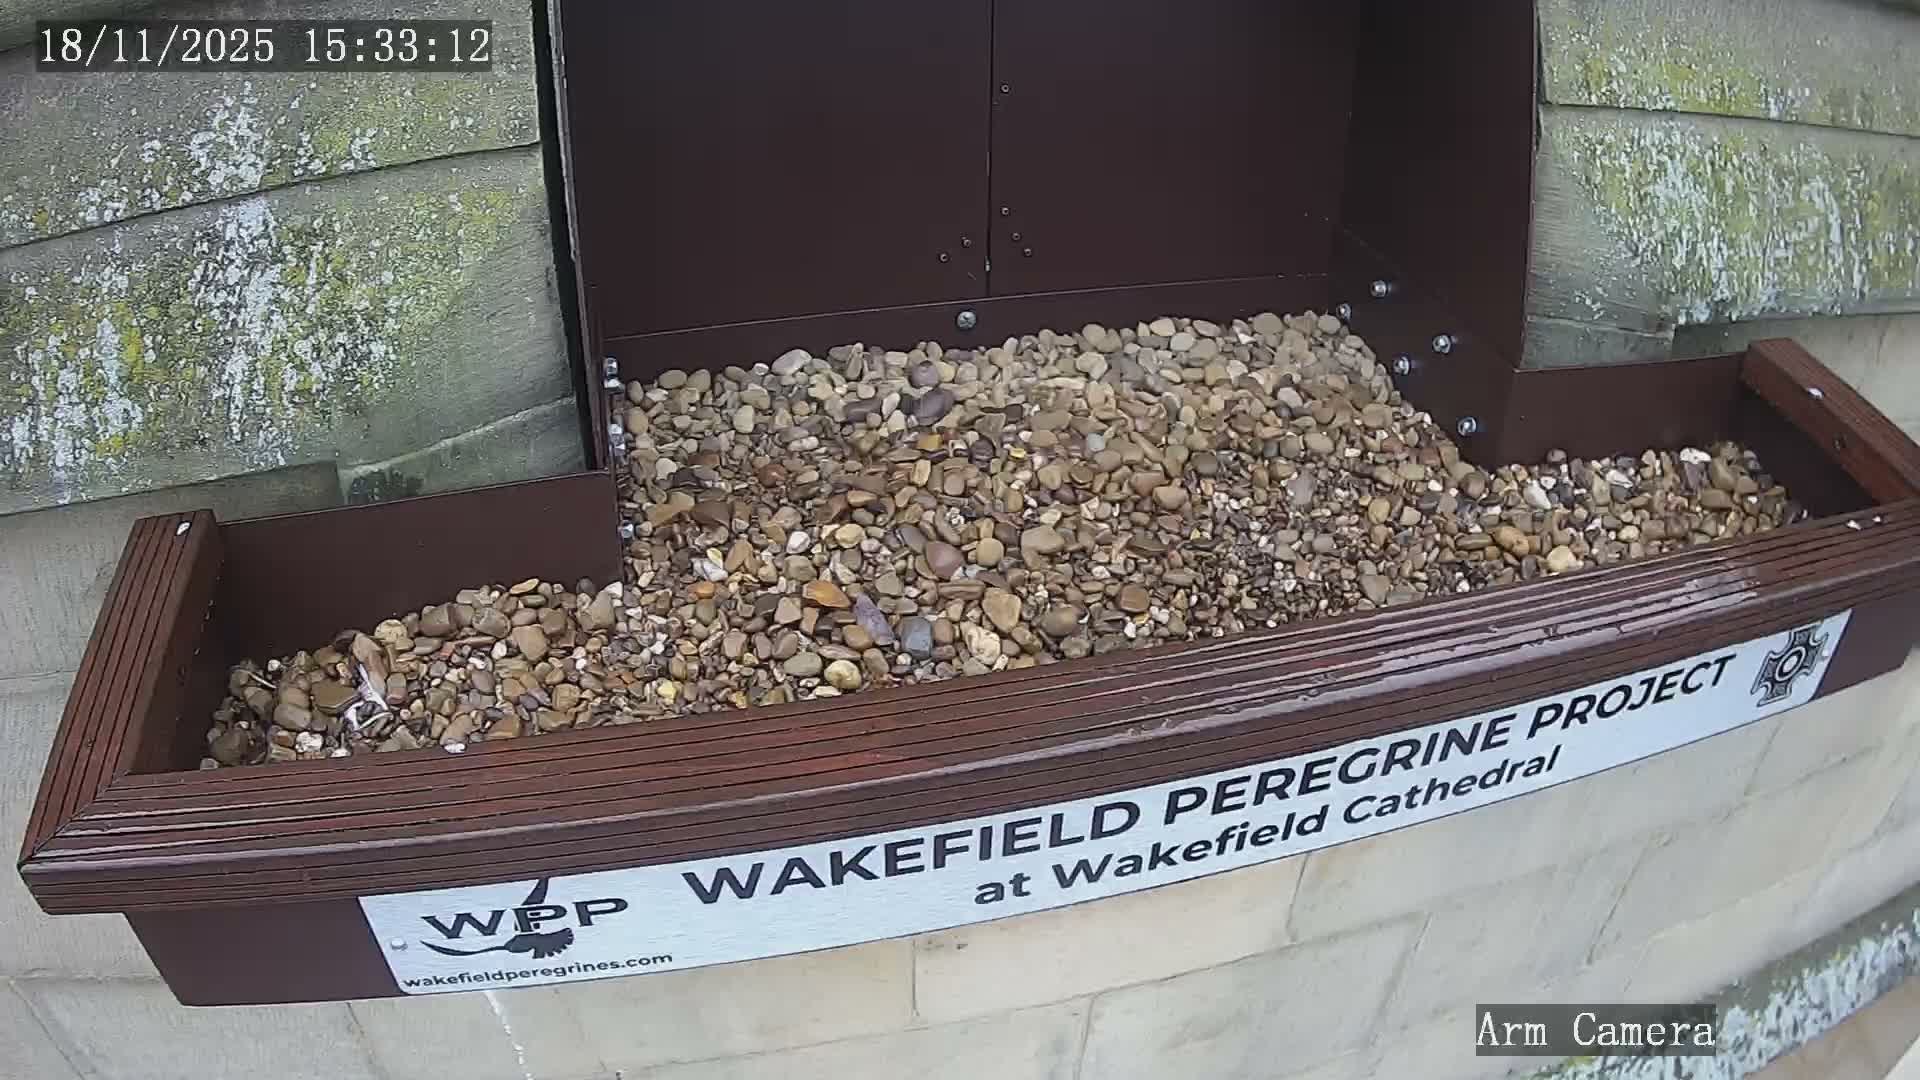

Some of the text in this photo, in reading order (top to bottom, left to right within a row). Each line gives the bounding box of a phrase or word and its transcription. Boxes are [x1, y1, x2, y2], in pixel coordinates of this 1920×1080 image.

[682, 653, 1737, 905] WAKEFIELD PEREGRINE PROJECT
[974, 745, 1562, 904] at Wakefield Cathedral
[421, 898, 629, 940] WPP
[402, 953, 673, 988] wakefieldperegrines.com
